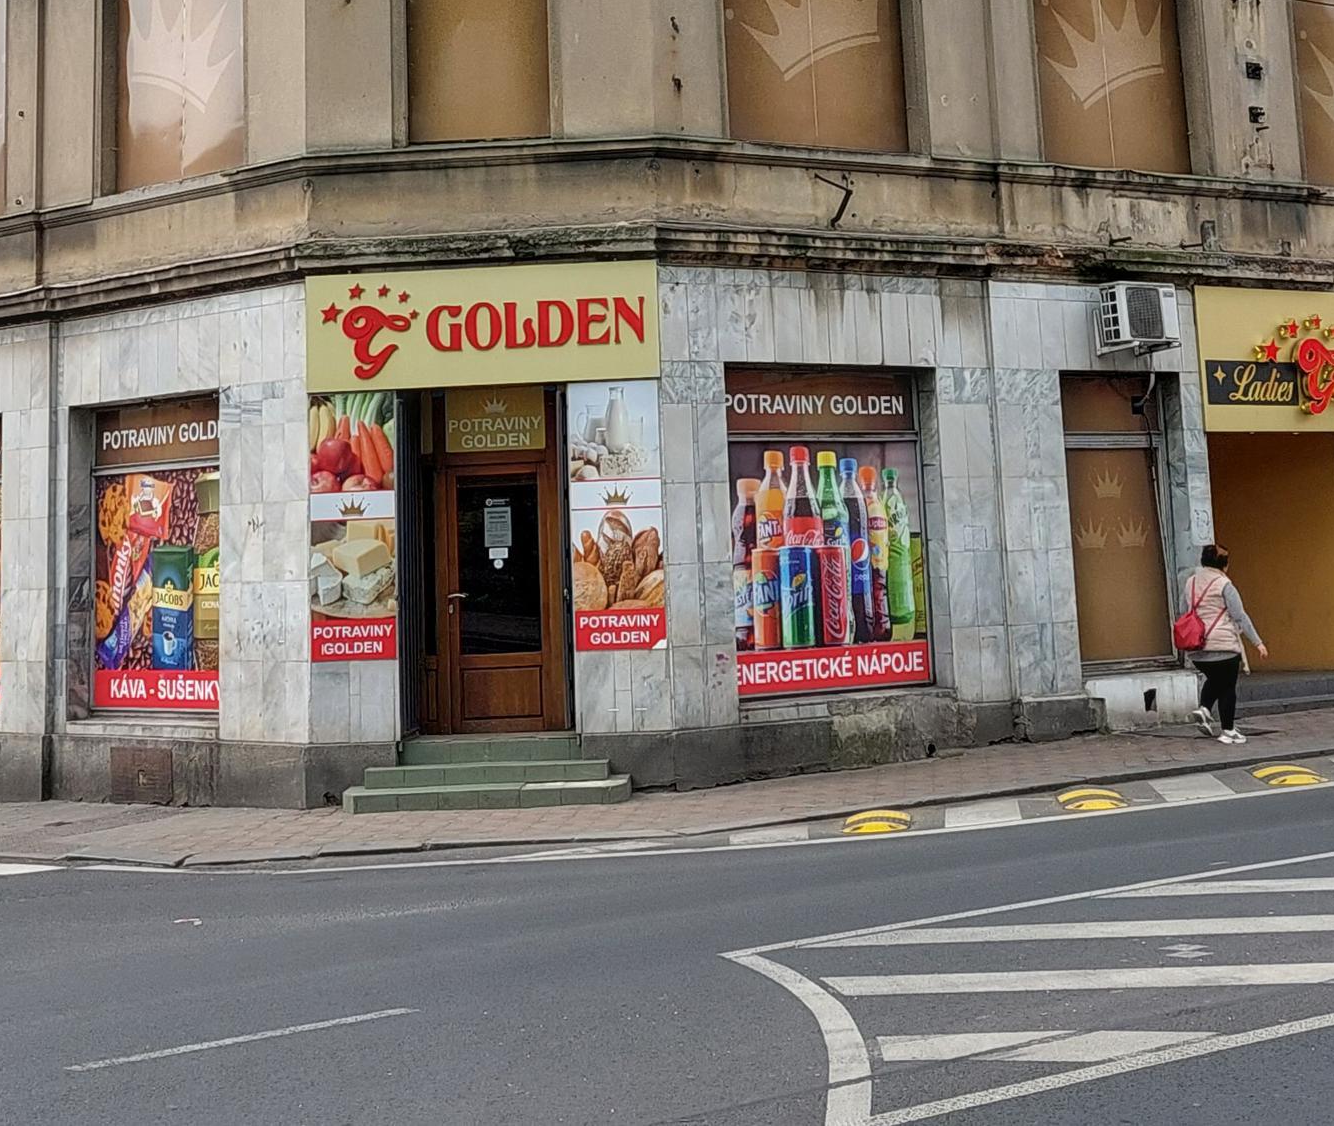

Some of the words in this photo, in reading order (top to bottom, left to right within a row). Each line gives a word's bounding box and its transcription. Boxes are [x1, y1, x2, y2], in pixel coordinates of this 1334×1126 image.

[426, 296, 645, 352] GOLDEN
[1229, 363, 1294, 402] Ladies
[725, 393, 825, 415] POTRAVINY
[830, 395, 904, 415] GOLDEN
[448, 416, 542, 433] POTRAVINY
[103, 424, 176, 451] POTRAVINY
[461, 432, 531, 449] GOLDEN
[156, 592, 184, 606] JACOBS
[579, 614, 660, 629] POTRAVINY
[313, 624, 393, 640] POTRAVINY
[590, 631, 650, 645] GOLDEN
[737, 651, 853, 686] ENERGETICKÉ
[857, 649, 924, 676] NÁPOJE
[110, 674, 146, 699] KÁVA
